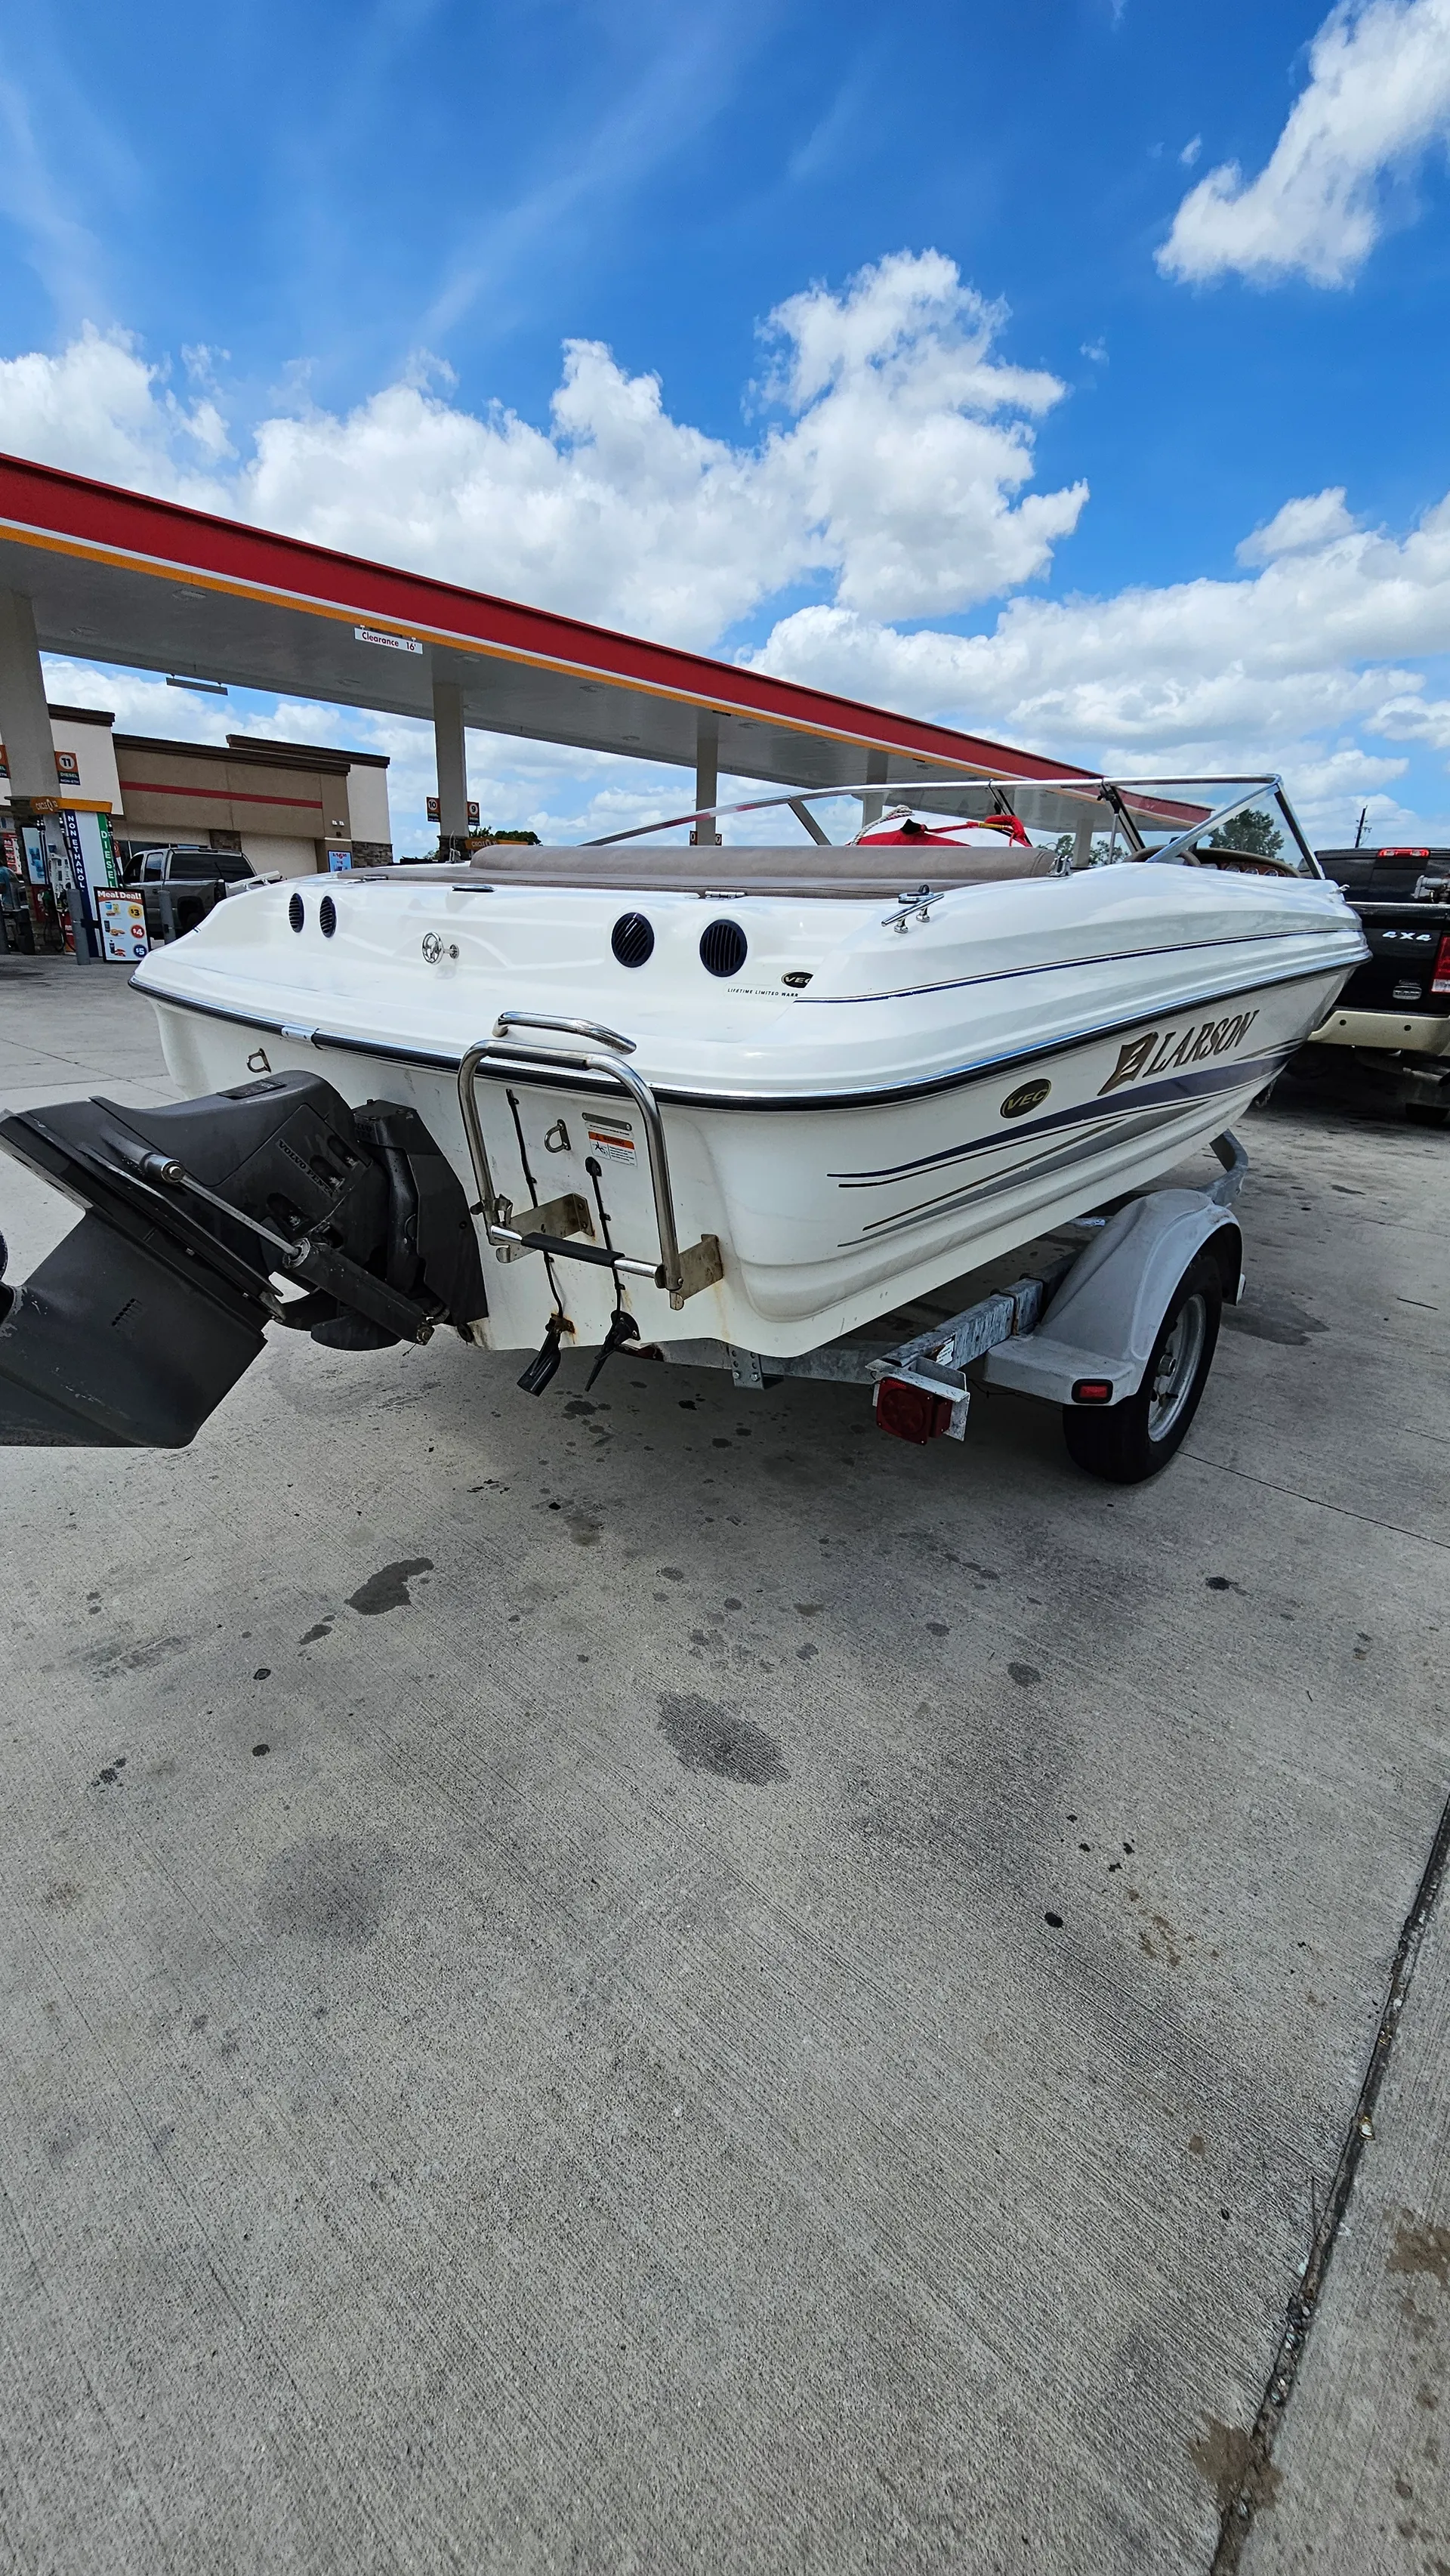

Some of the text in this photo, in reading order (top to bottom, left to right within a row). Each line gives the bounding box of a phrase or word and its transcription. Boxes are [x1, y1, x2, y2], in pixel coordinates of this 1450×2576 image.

[362, 632, 417, 651] Clearance 16'
[61, 758, 72, 767] 11
[67, 815, 85, 888] NON ETHANOL
[100, 830, 116, 888] DIESEL
[97, 890, 119, 899] Meal
[133, 928, 143, 936] $4
[1142, 1009, 1260, 1079] LARSON
[1006, 1089, 1048, 1110] VEC
[279, 1139, 307, 1169] VOLVO
